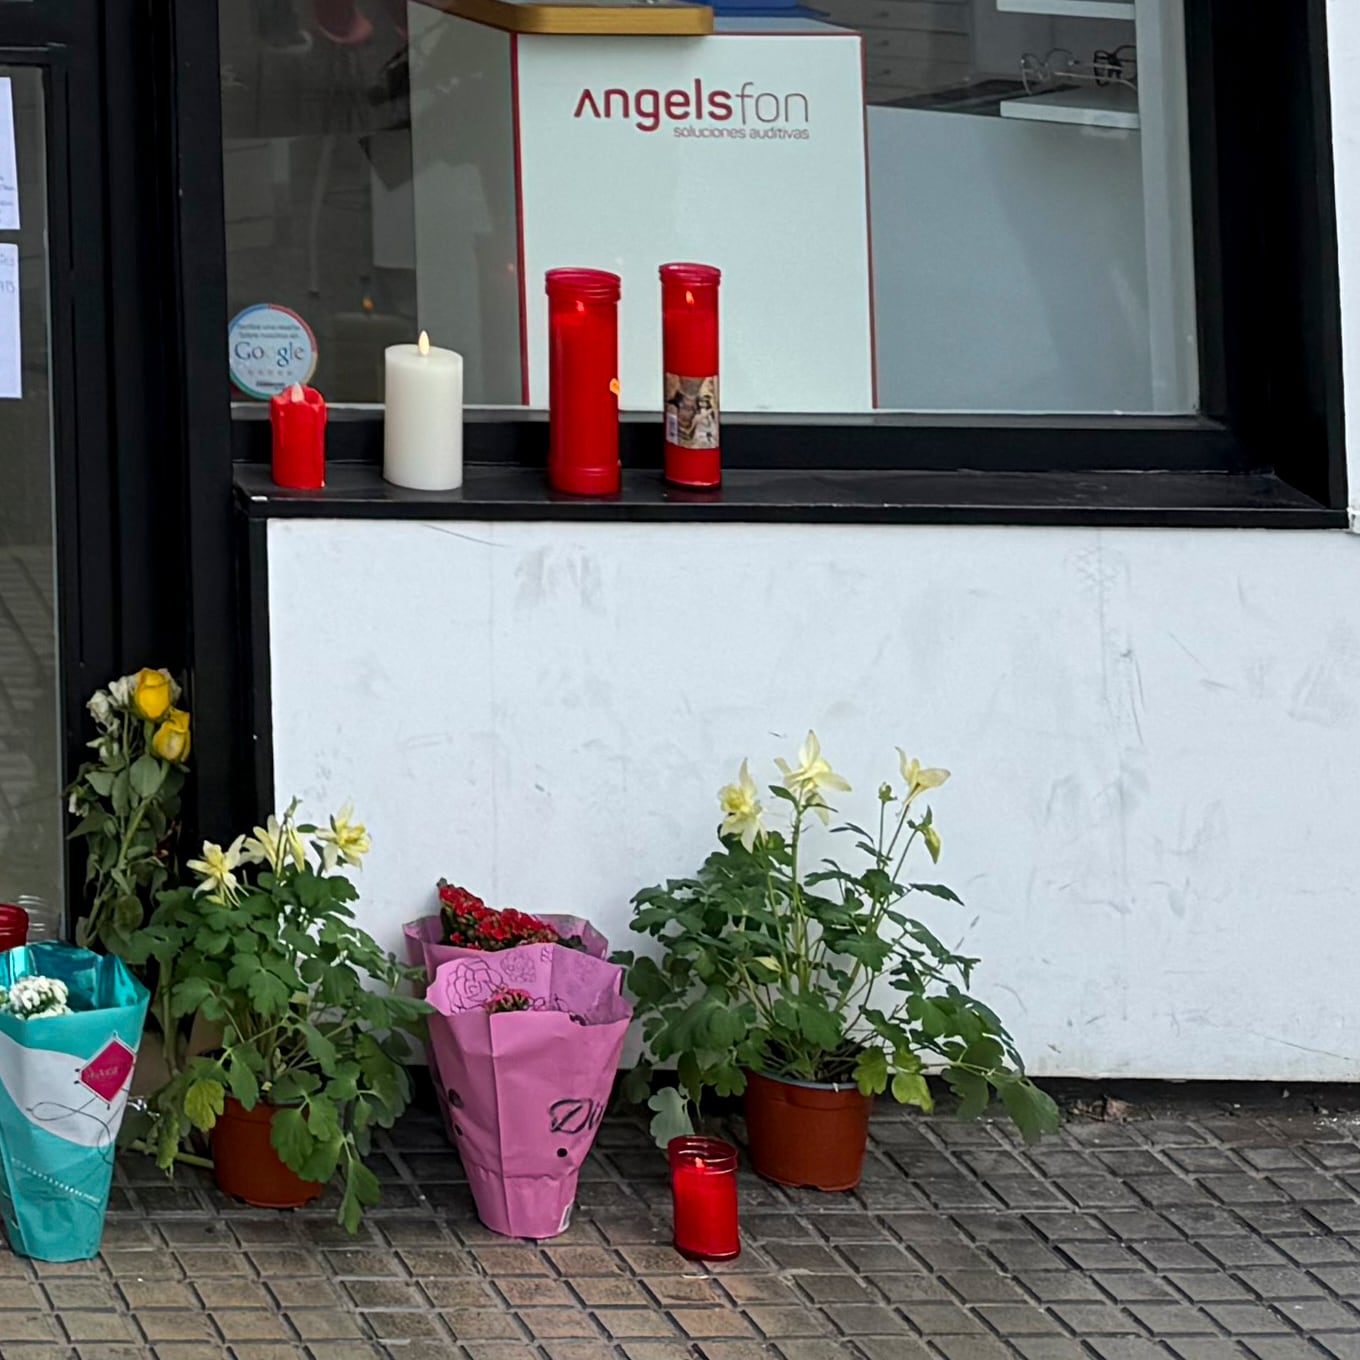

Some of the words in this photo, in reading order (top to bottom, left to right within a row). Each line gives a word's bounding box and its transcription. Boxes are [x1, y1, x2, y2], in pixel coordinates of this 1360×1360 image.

[673, 127, 746, 139] soluciones
[749, 127, 809, 140] auditivas
[234, 341, 304, 367] Gogle
